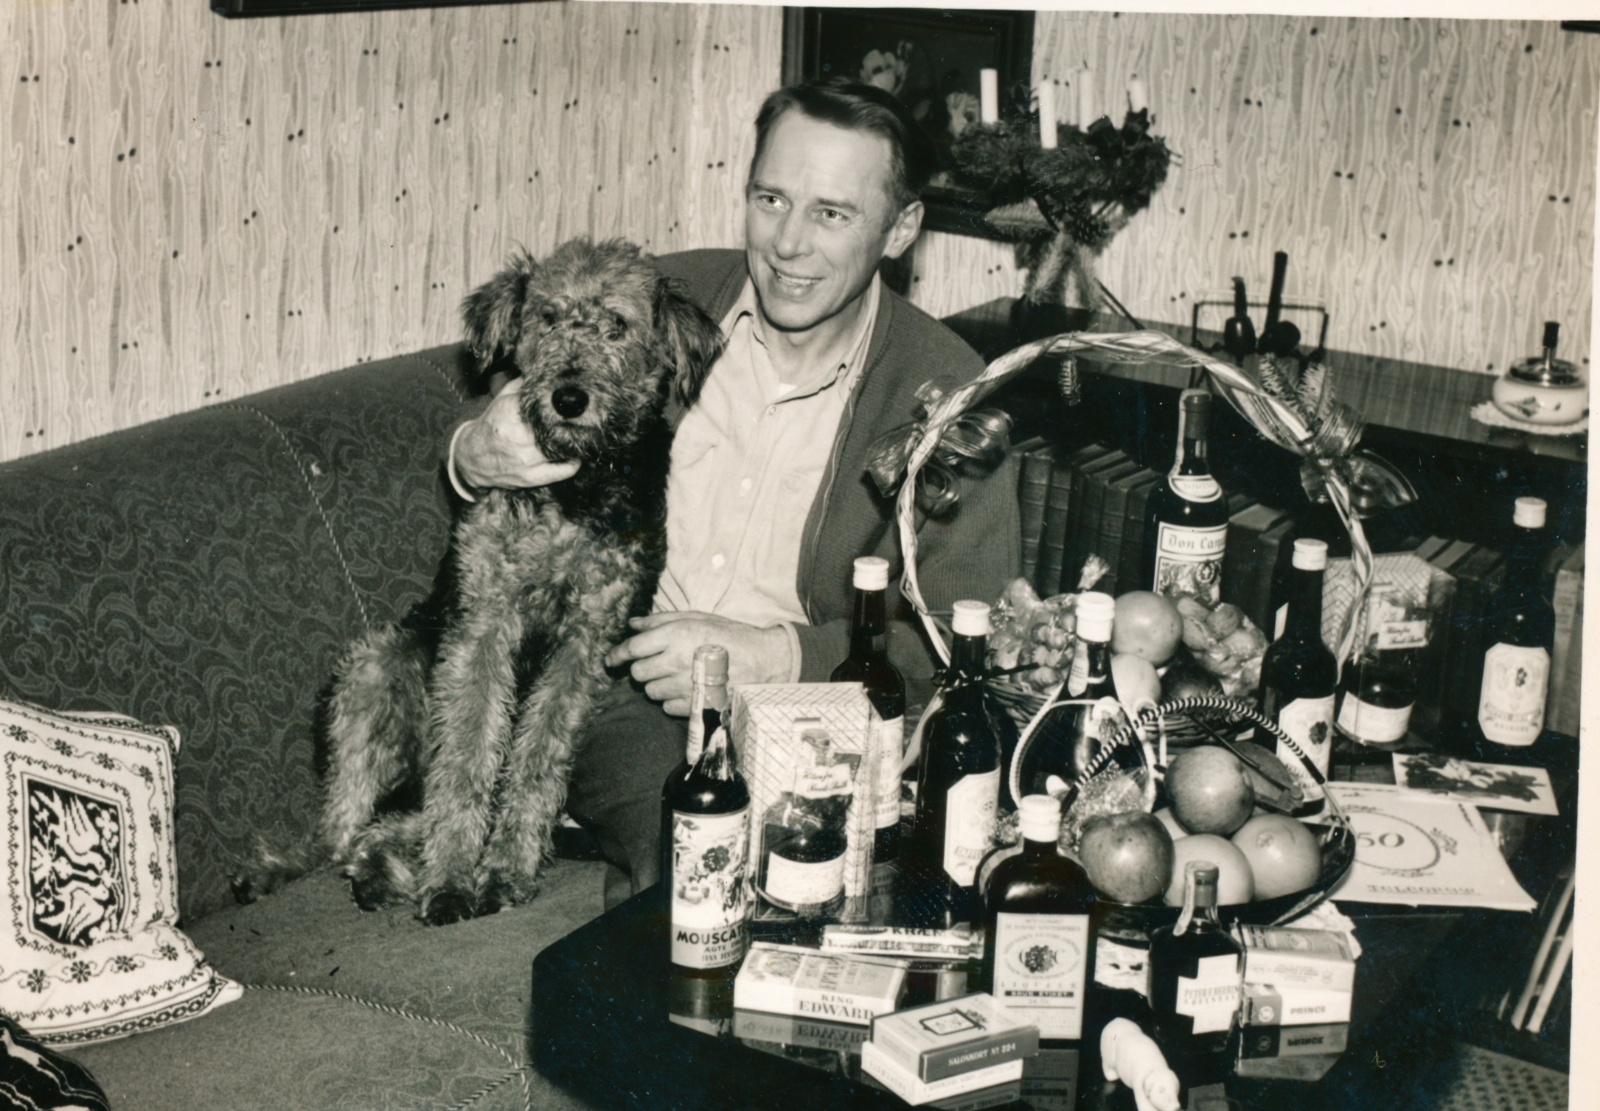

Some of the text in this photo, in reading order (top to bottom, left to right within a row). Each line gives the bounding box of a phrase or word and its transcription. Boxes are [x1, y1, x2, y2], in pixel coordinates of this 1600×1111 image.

[1169, 534, 1195, 550] Don
[1356, 831, 1405, 849] 50
[821, 994, 854, 1005] KING
[800, 1001, 876, 1021] EDWARD
[1291, 1006, 1326, 1015] PRINCE
